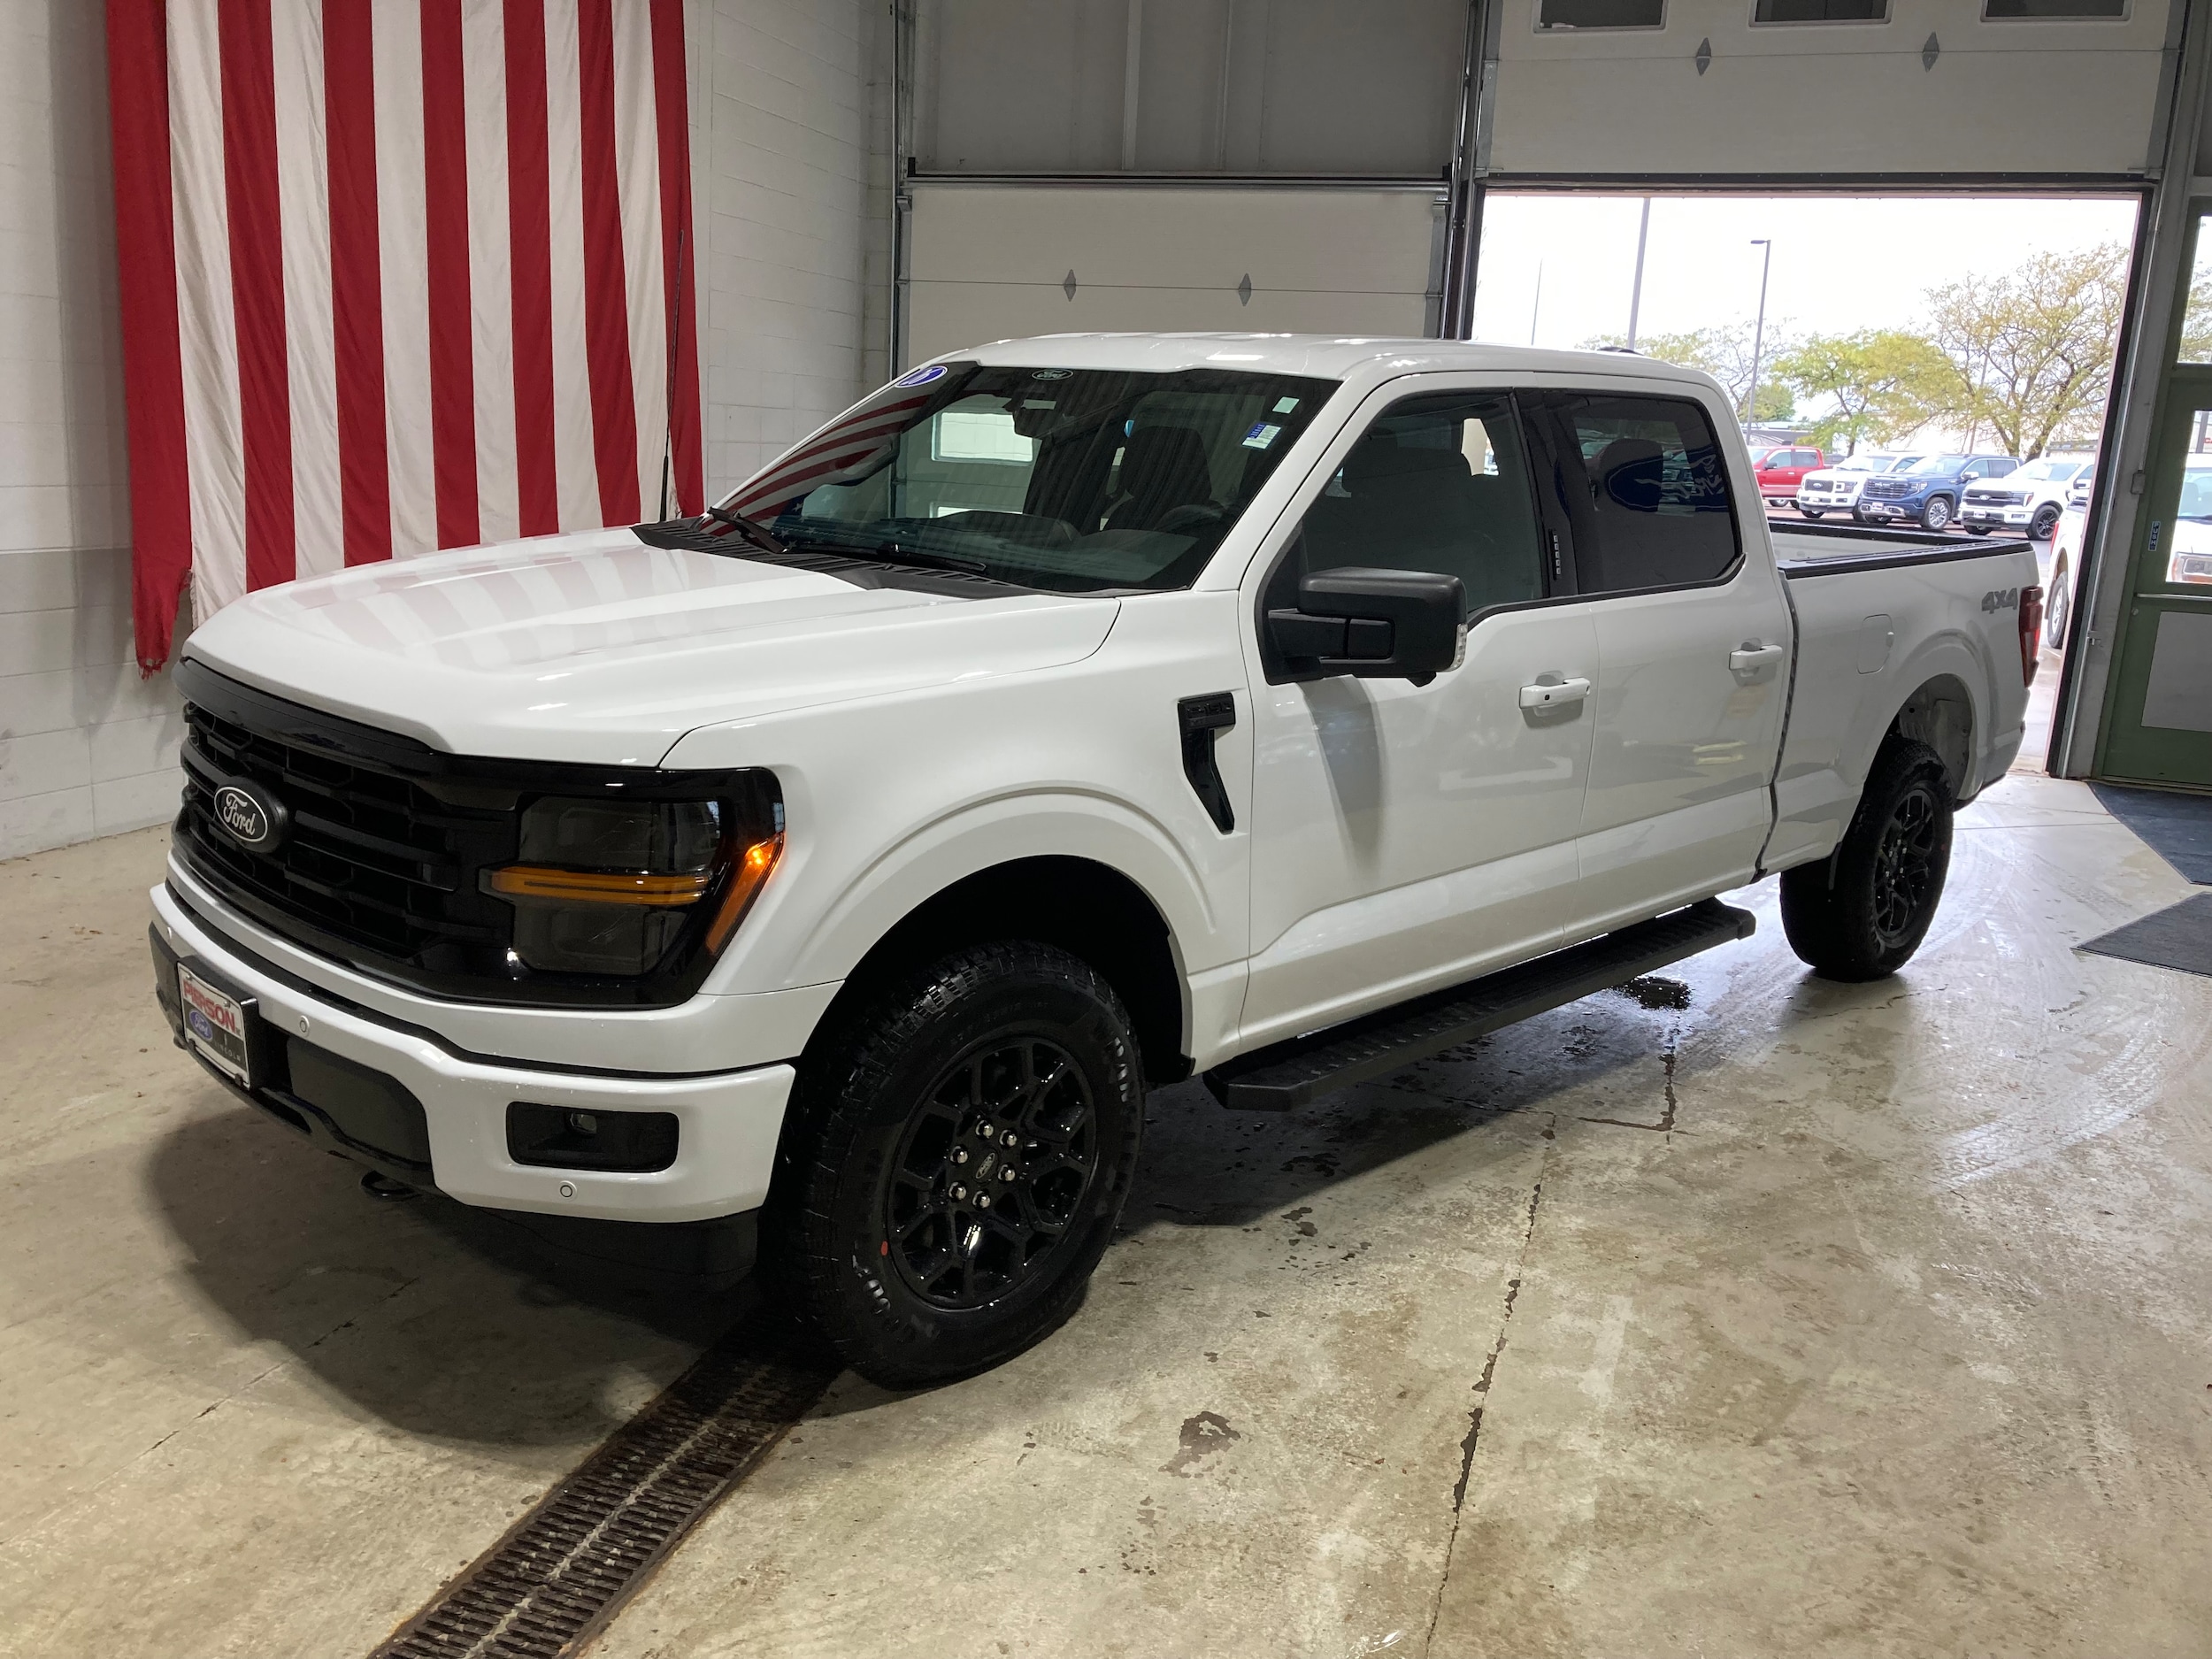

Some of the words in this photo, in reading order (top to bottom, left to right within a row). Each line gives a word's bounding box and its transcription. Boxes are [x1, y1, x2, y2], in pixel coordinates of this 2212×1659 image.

[2150, 521, 2160, 545] PUSH
[223, 792, 256, 836] Ford
[182, 979, 236, 1034] PIERSON
[193, 1012, 211, 1039] Ford
